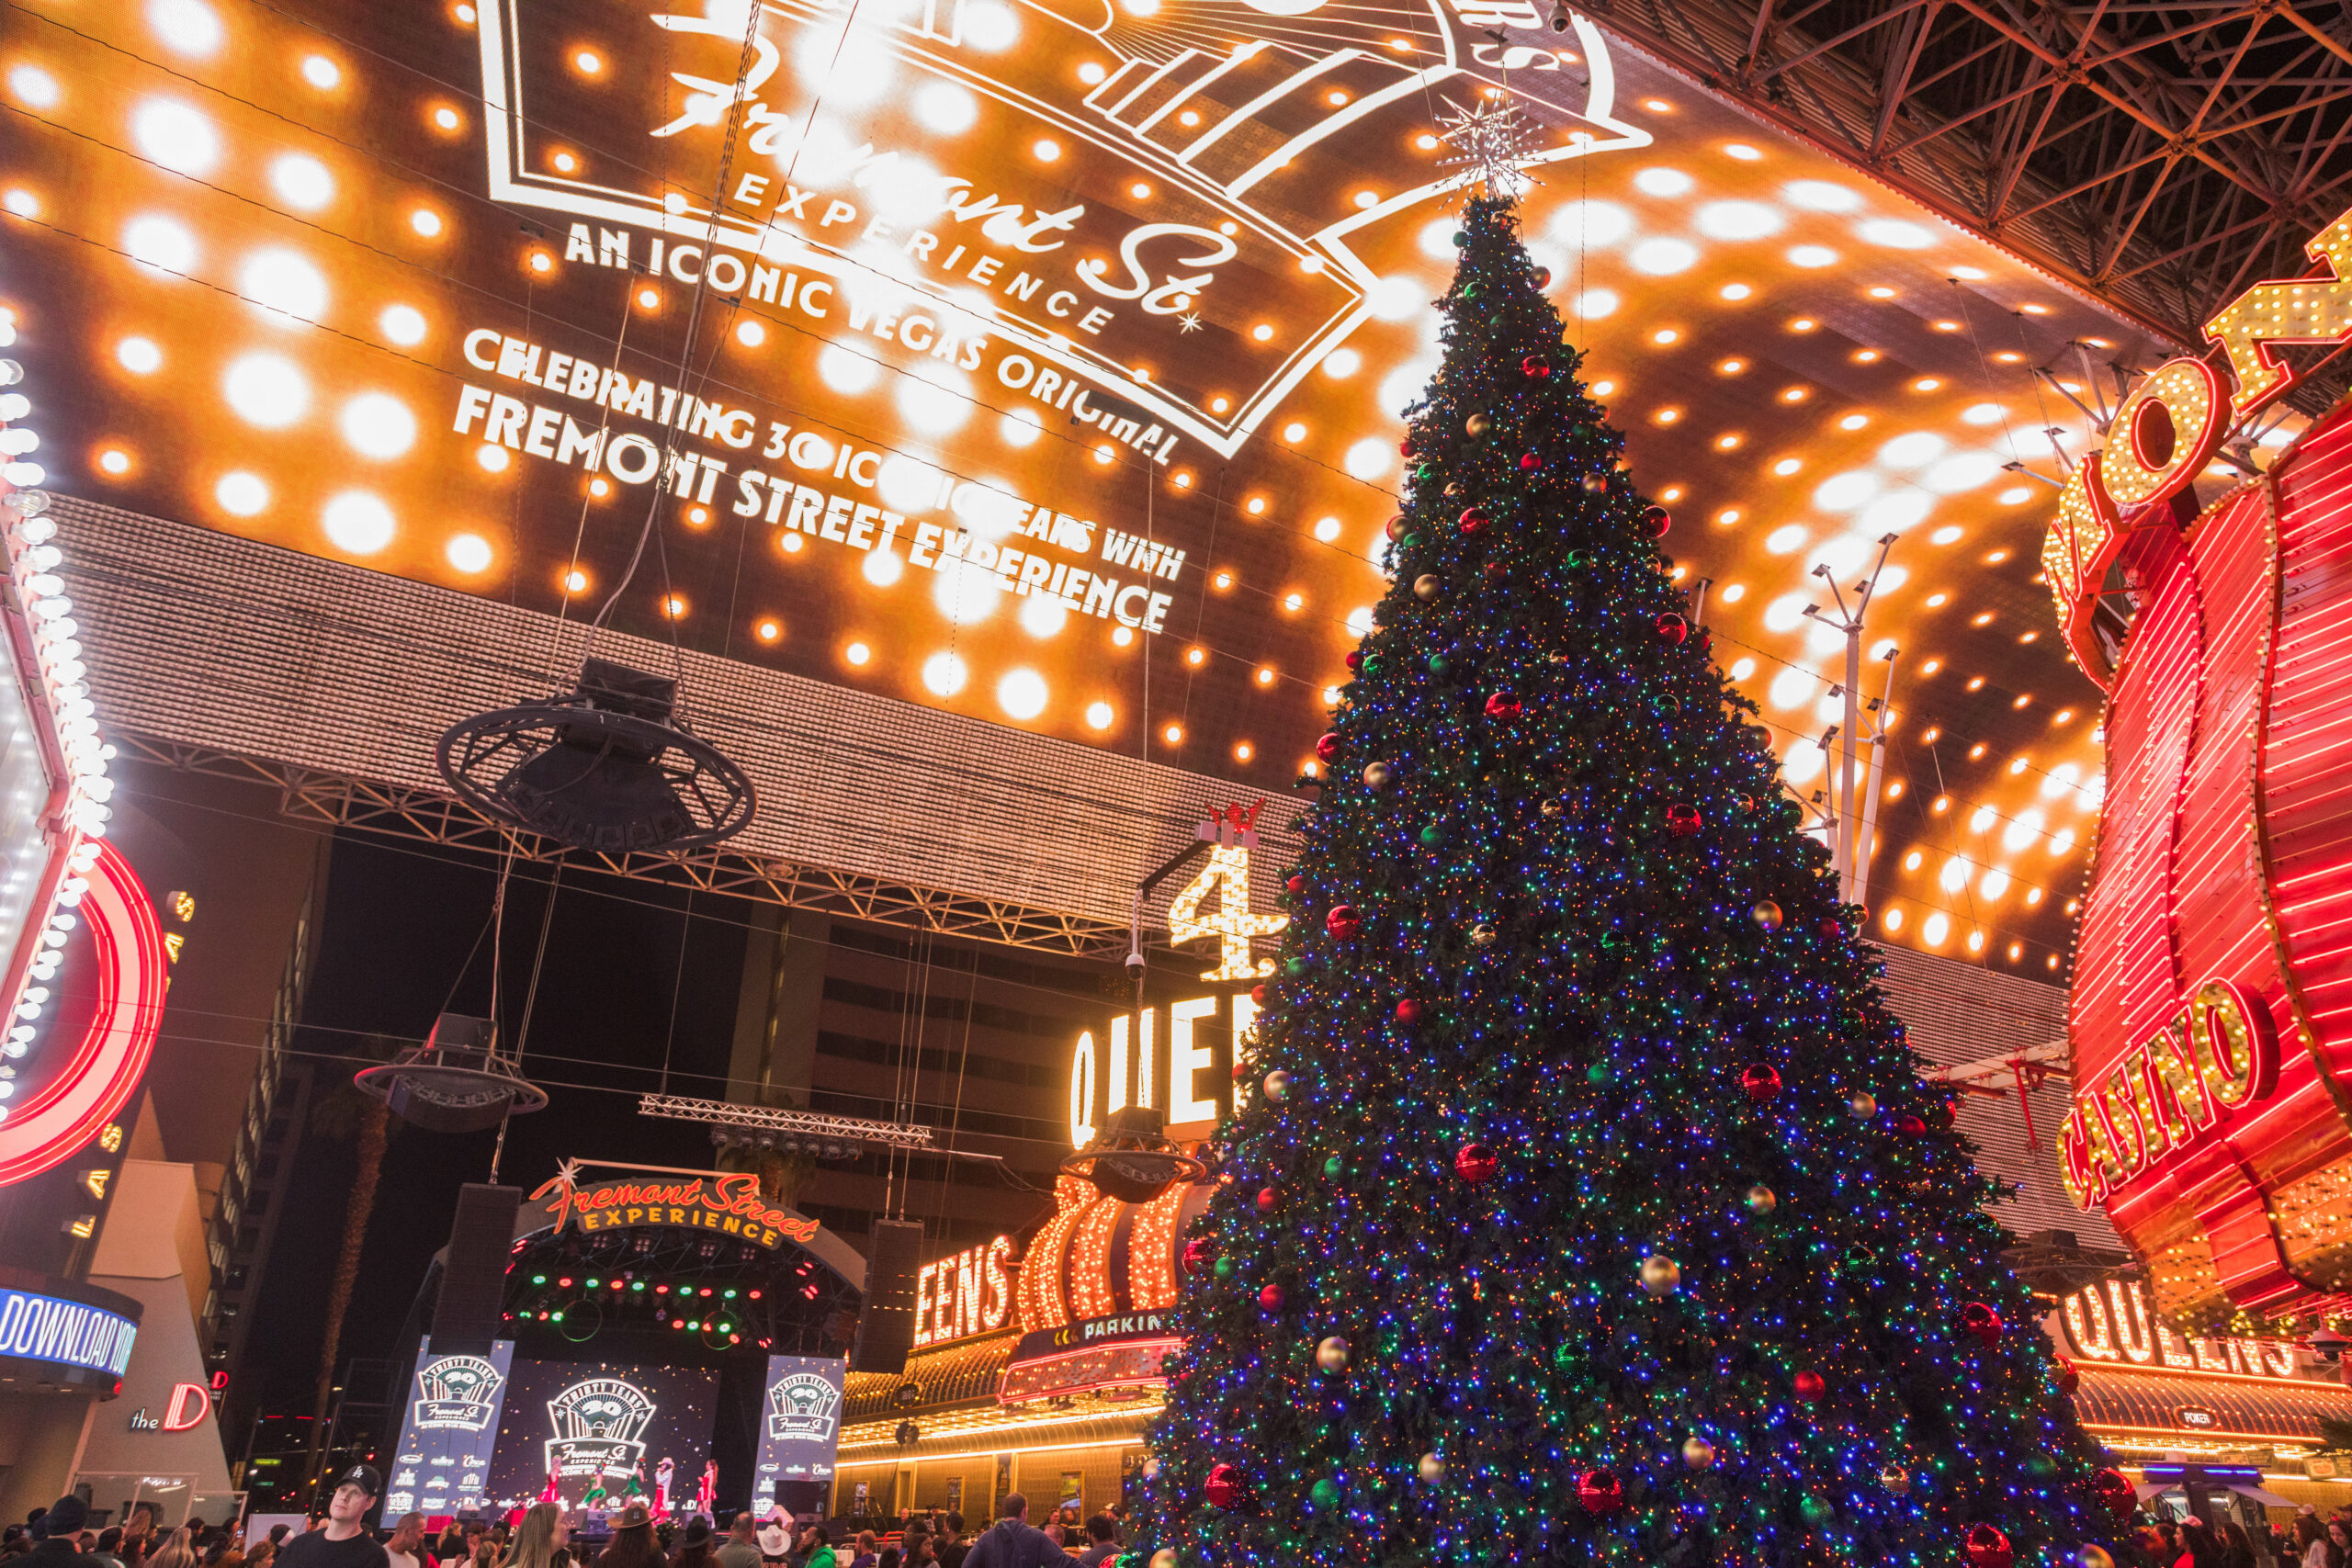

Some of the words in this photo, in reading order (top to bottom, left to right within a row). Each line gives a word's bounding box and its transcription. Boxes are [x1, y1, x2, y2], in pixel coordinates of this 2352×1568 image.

[733, 173, 1114, 336] EXPERIENCE
[564, 221, 630, 270] AN
[648, 238, 833, 319] ICONIC
[846, 299, 989, 372] VEGAS
[463, 328, 757, 448] CELEBRATING
[1102, 528, 1186, 581] WITH
[453, 384, 728, 504] FREMONT
[732, 469, 905, 553] STREET
[909, 522, 1173, 635] EXPERIENCE
[1168, 843, 1288, 982] 4
[2056, 976, 2264, 1213] CASINO
[529, 1174, 703, 1235] Fremont
[700, 1173, 820, 1242] Street
[584, 1206, 782, 1247] EXPERIENCE
[0, 1294, 119, 1368] DOWNLOAD
[430, 1359, 465, 1376] THIRTY
[469, 1359, 493, 1378] YEARS
[562, 1382, 607, 1406] THIRTY
[612, 1383, 643, 1408] YEARS
[778, 1376, 807, 1391] THIRTY
[810, 1377, 832, 1394] YEARS
[131, 1407, 159, 1429] the
[163, 1382, 209, 1431] D
[2184, 1412, 2211, 1424] POKER
[561, 1443, 609, 1461] Fremont
